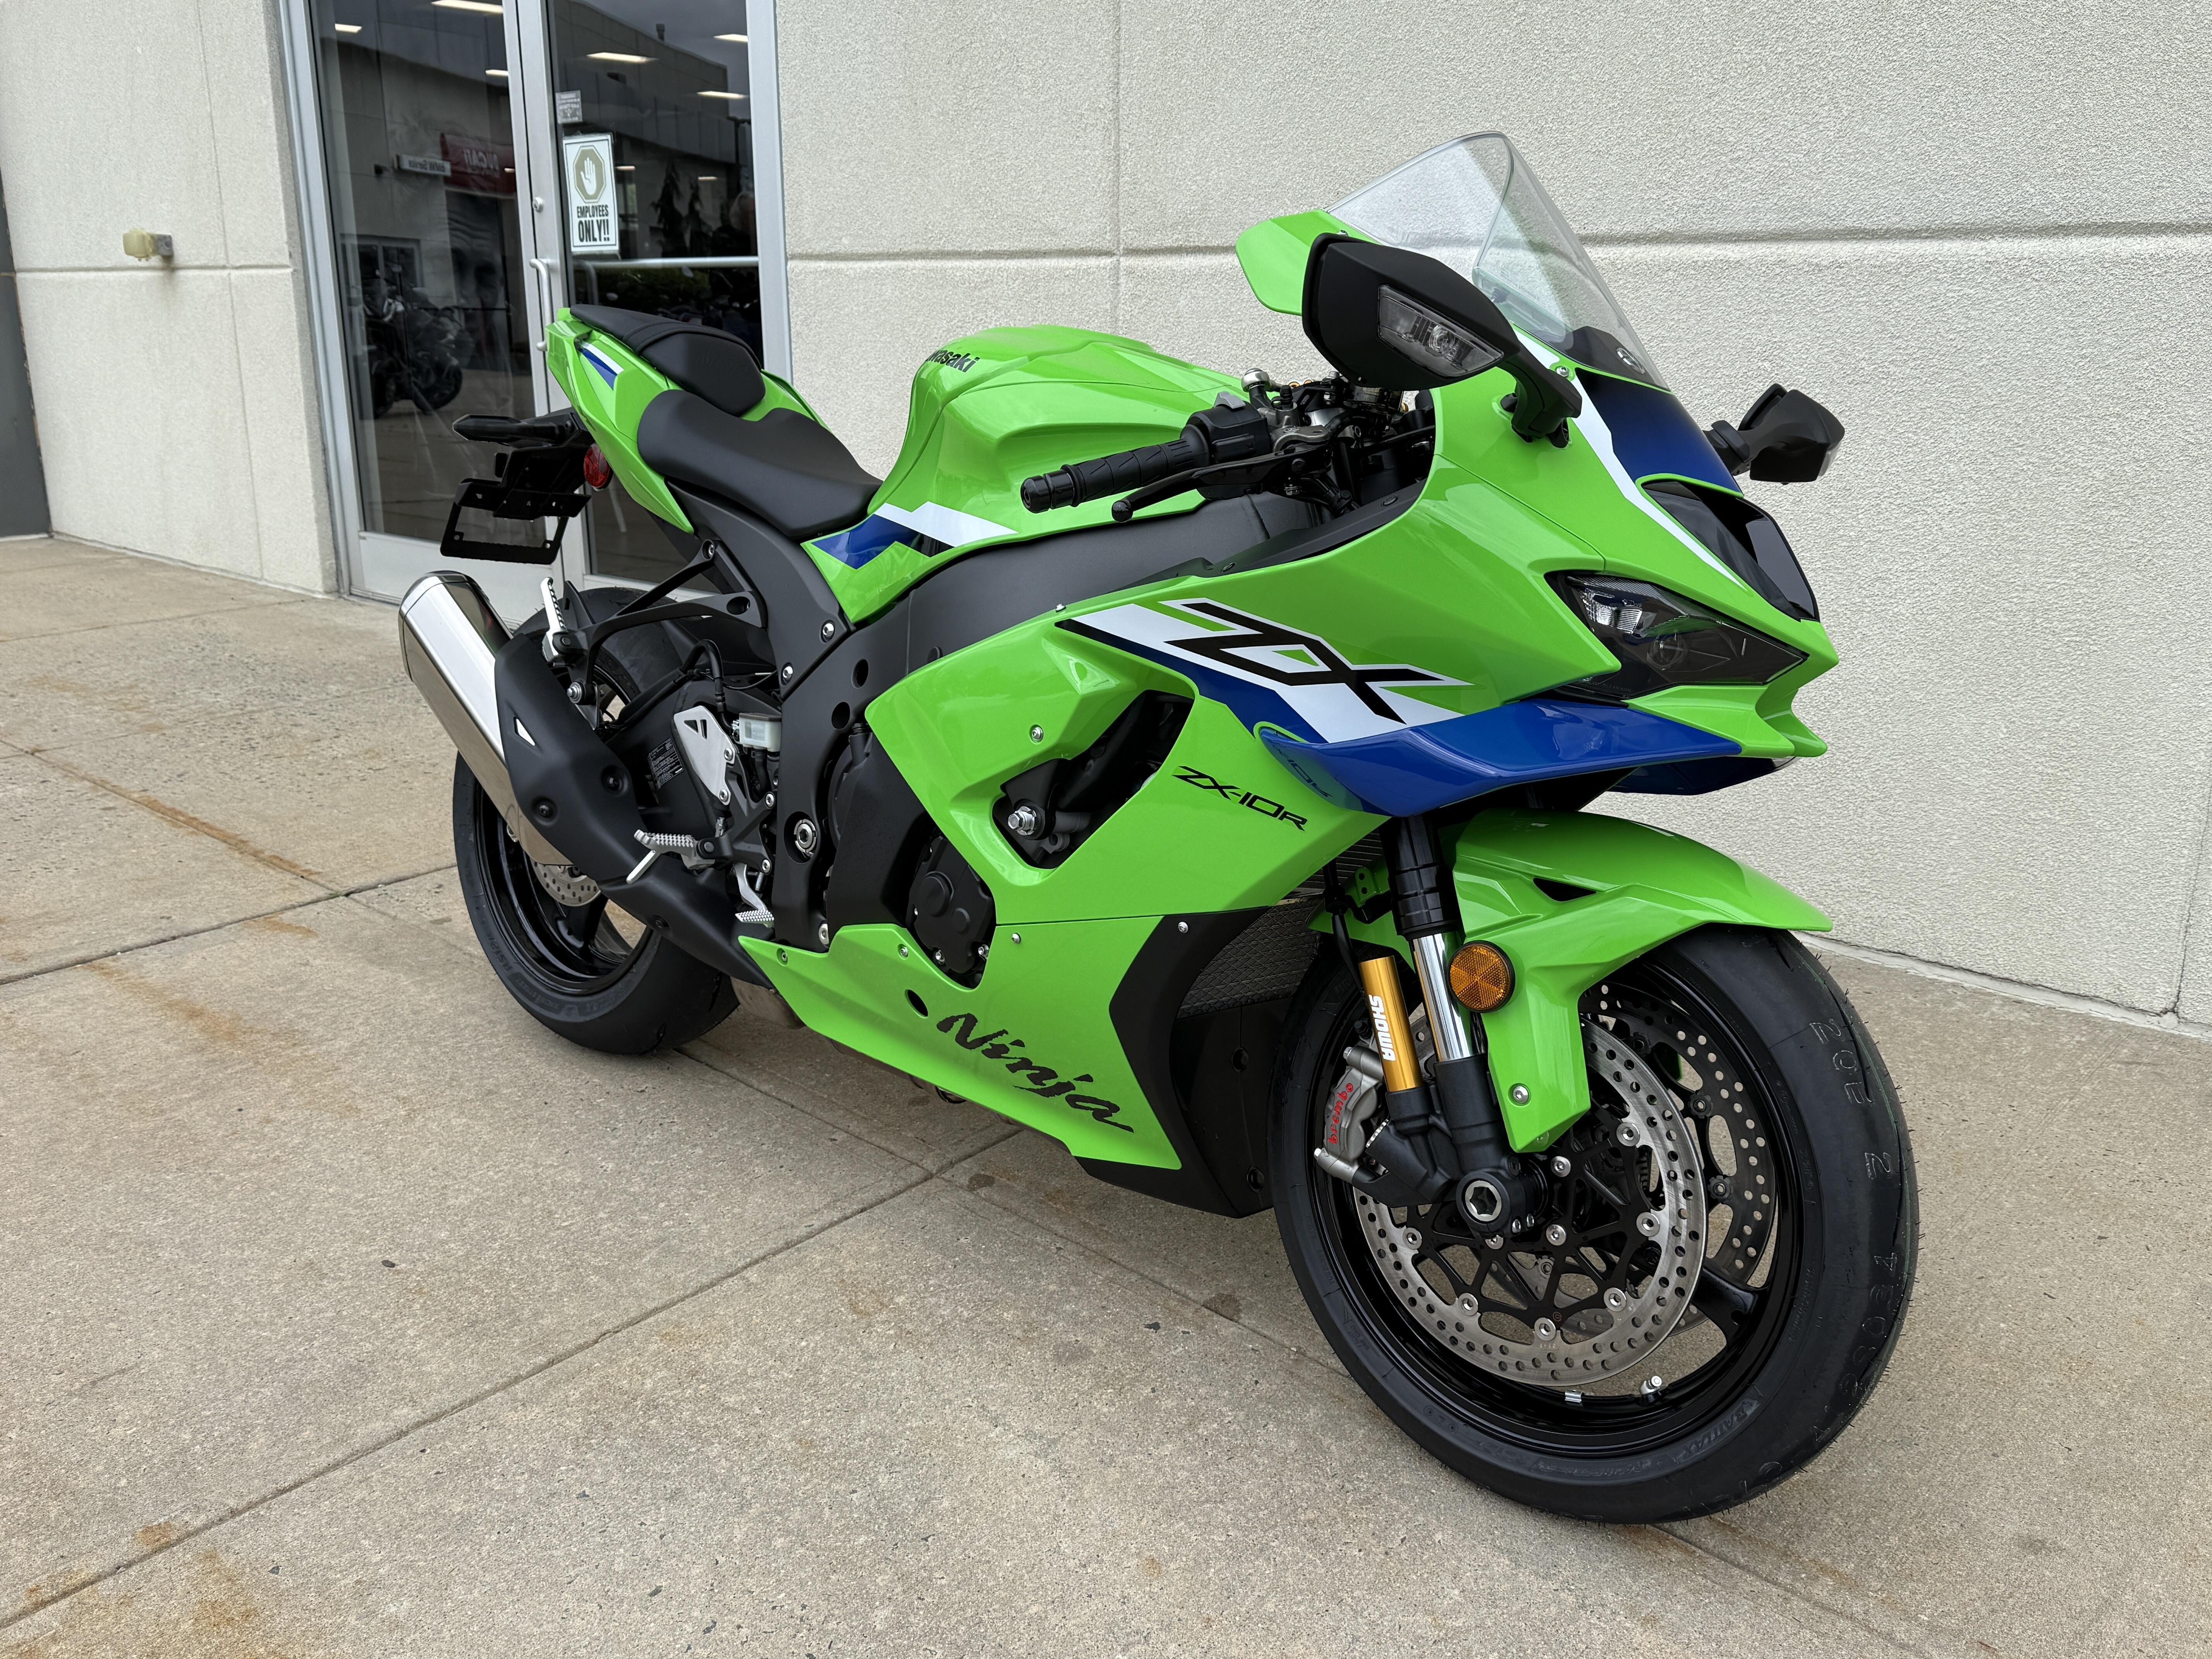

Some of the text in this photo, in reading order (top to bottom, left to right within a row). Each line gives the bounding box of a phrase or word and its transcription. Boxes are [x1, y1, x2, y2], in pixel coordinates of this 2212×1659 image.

[577, 204, 609, 218] EMPLOYEES
[578, 219, 610, 242] ONLY!!
[926, 349, 980, 373] wasaki
[1162, 602, 1445, 725] ZX
[1172, 766, 1308, 831] ZX-10R
[1369, 994, 1396, 1061] SHOWA
[936, 1013, 1134, 1133] Ninja
[1327, 1082, 1354, 1144] brembo
